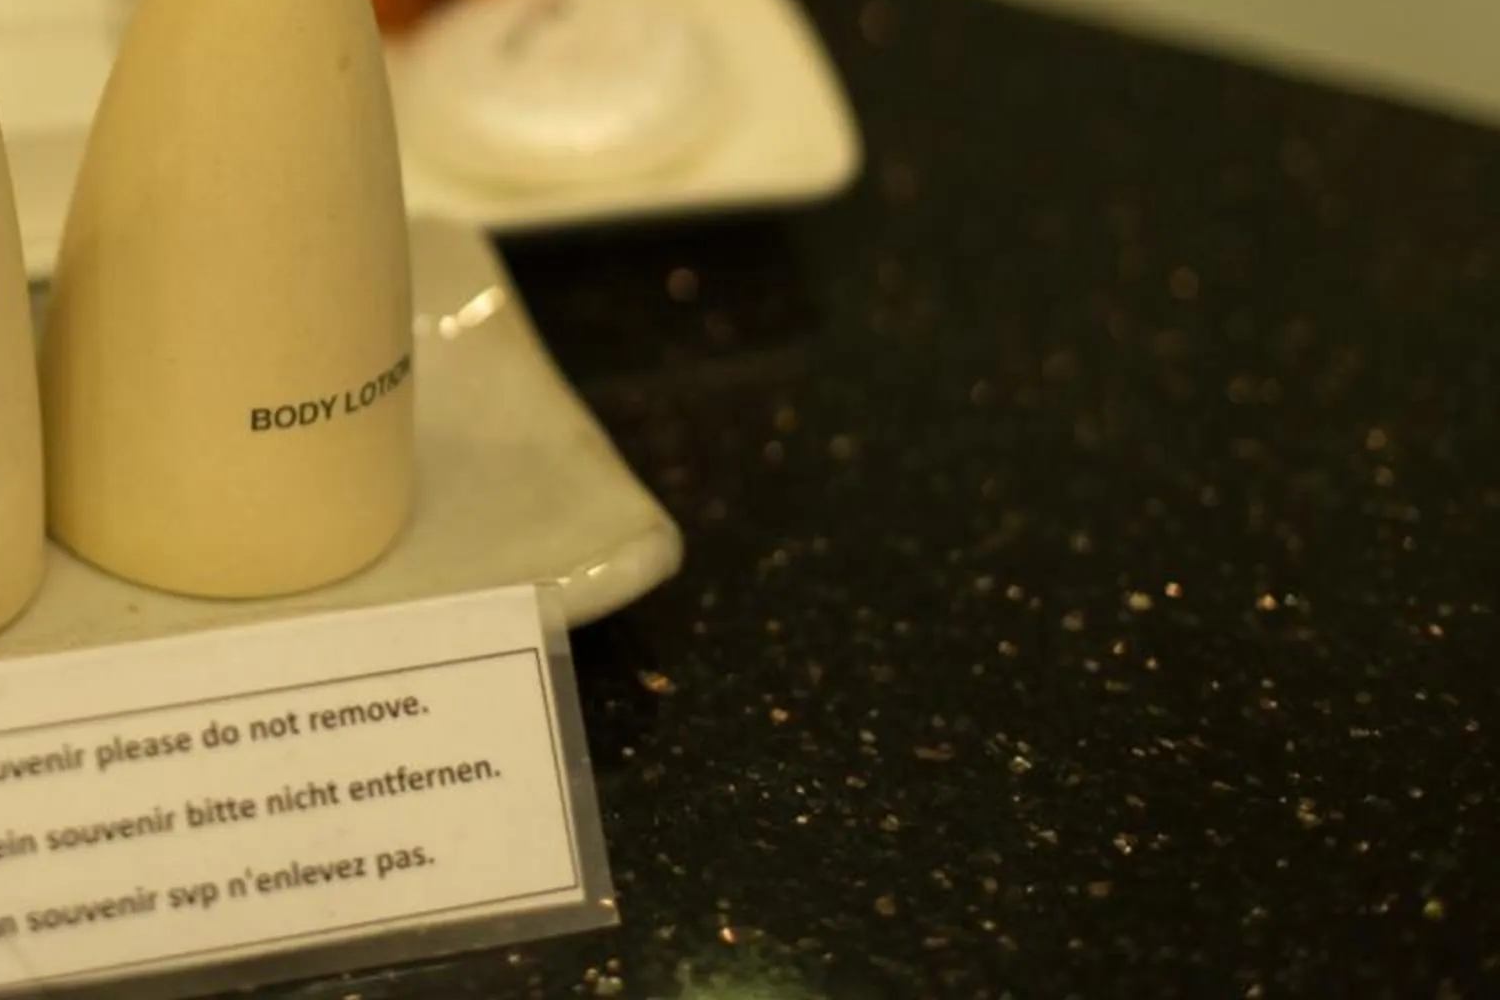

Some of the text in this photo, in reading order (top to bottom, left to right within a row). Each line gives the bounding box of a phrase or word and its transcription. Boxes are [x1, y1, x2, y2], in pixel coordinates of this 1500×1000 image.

[251, 394, 337, 432] BODY
[95, 728, 192, 771] please
[202, 720, 240, 750] do
[250, 711, 301, 742] not
[308, 693, 430, 734] remove.
[45, 806, 176, 852] souvenir
[185, 794, 258, 831] bitte
[266, 781, 340, 818] nicht
[348, 755, 502, 803] entfernen.
[25, 886, 158, 935] souvenir
[168, 880, 220, 911] svp
[228, 853, 367, 899] n'enlevez
[375, 842, 436, 883] pas.
